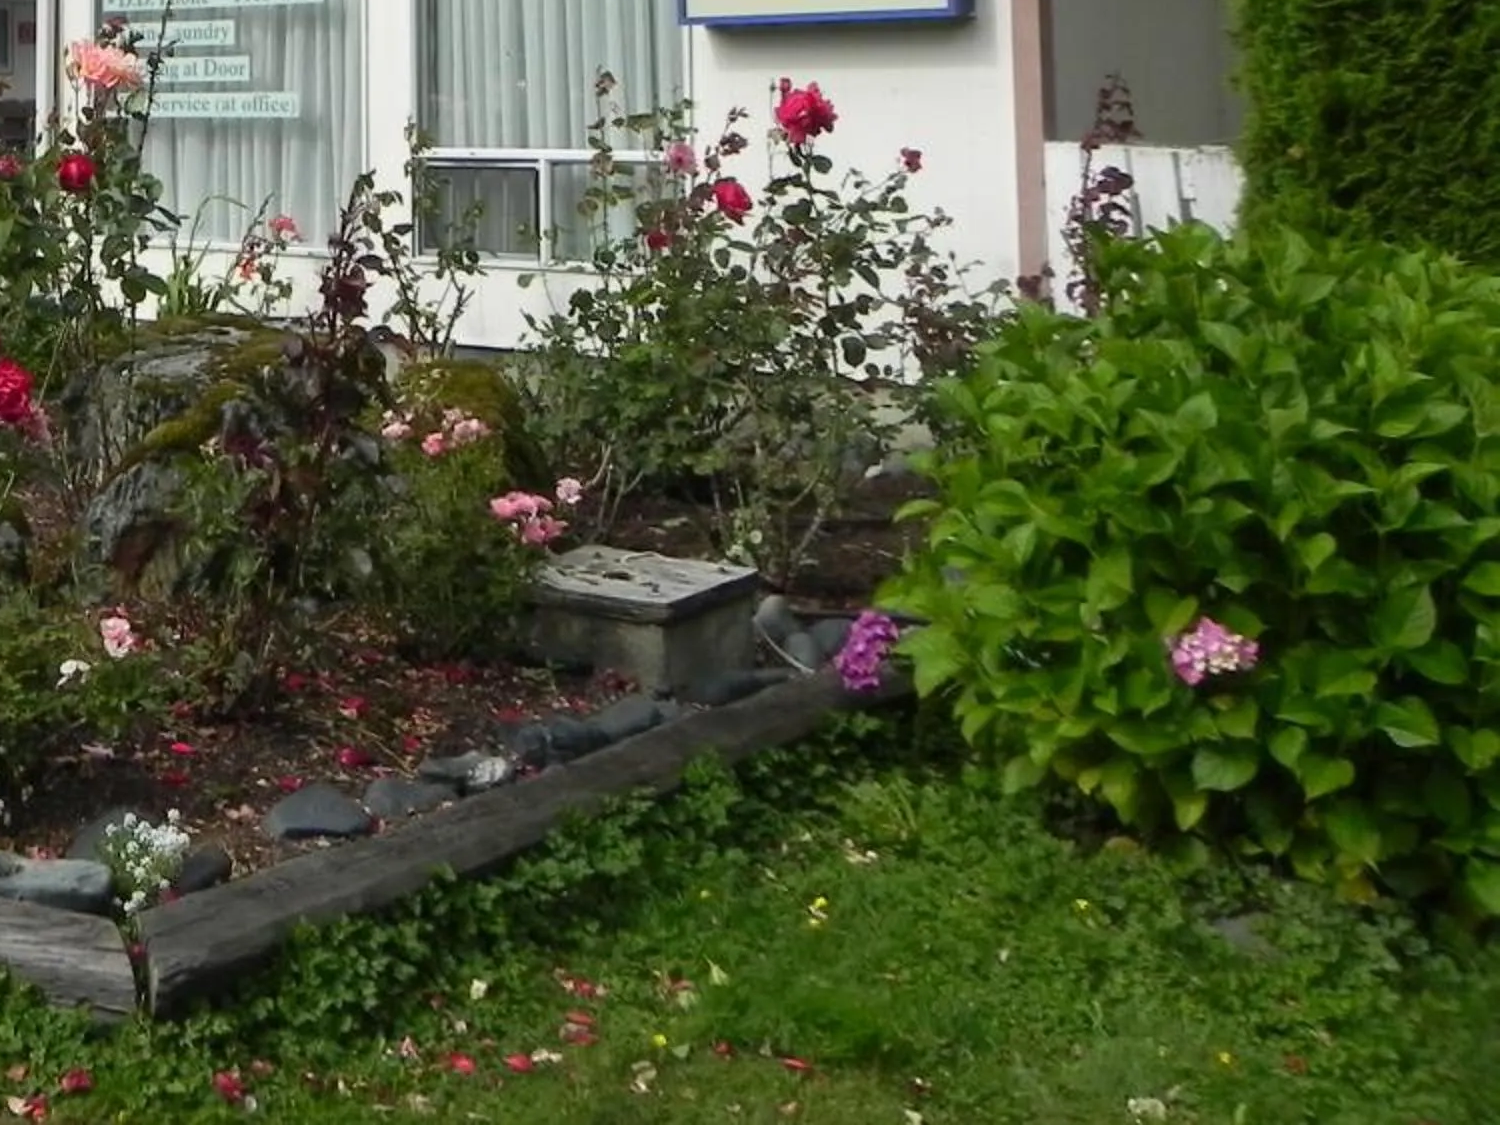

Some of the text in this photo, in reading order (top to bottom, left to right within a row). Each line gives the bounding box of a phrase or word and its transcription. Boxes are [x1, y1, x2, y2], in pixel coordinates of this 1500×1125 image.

[183, 62, 198, 77] at
[204, 58, 246, 77] Door
[151, 94, 211, 112] Service
